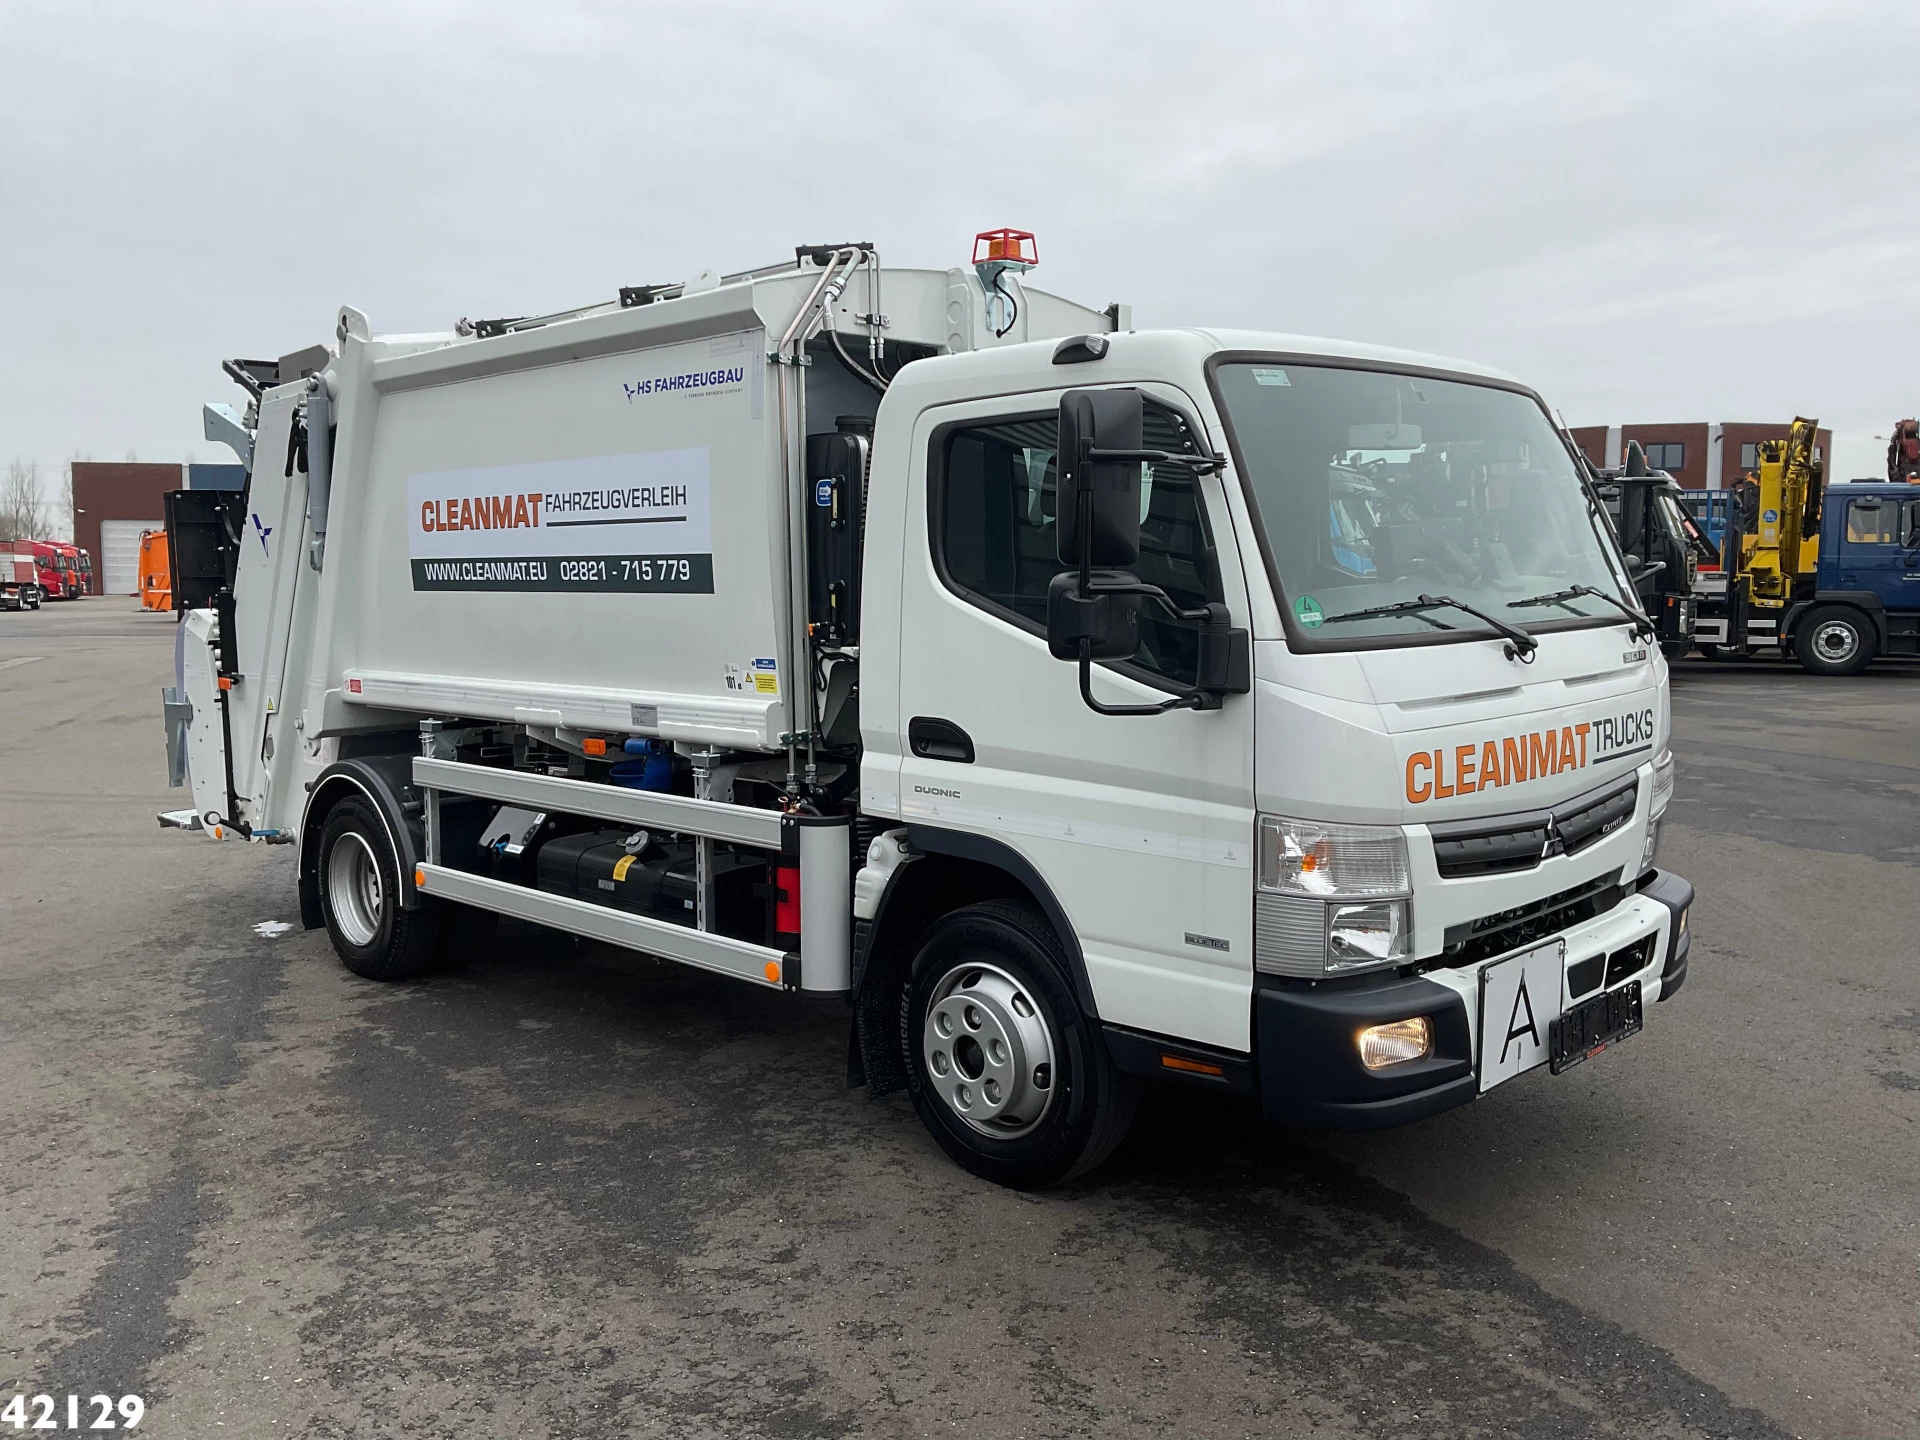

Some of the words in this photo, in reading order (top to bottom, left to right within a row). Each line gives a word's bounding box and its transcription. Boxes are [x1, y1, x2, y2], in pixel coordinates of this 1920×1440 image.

[637, 380, 652, 395] HS
[654, 367, 744, 393] FAHRZEUGBAU
[421, 493, 543, 532] CLEANMAT
[545, 485, 687, 512] FAHRZEUGVERLEIH
[424, 561, 548, 581] WWW.CLEANMAT.EU
[560, 561, 607, 581] 02821
[620, 560, 652, 581] 715
[656, 559, 691, 581] 779
[1303, 596, 1313, 613] 4
[1405, 722, 1591, 804] CLEANMAT
[1592, 708, 1653, 753] TRUCKS
[914, 785, 961, 799] DUONIC
[1499, 967, 1541, 1064] A
